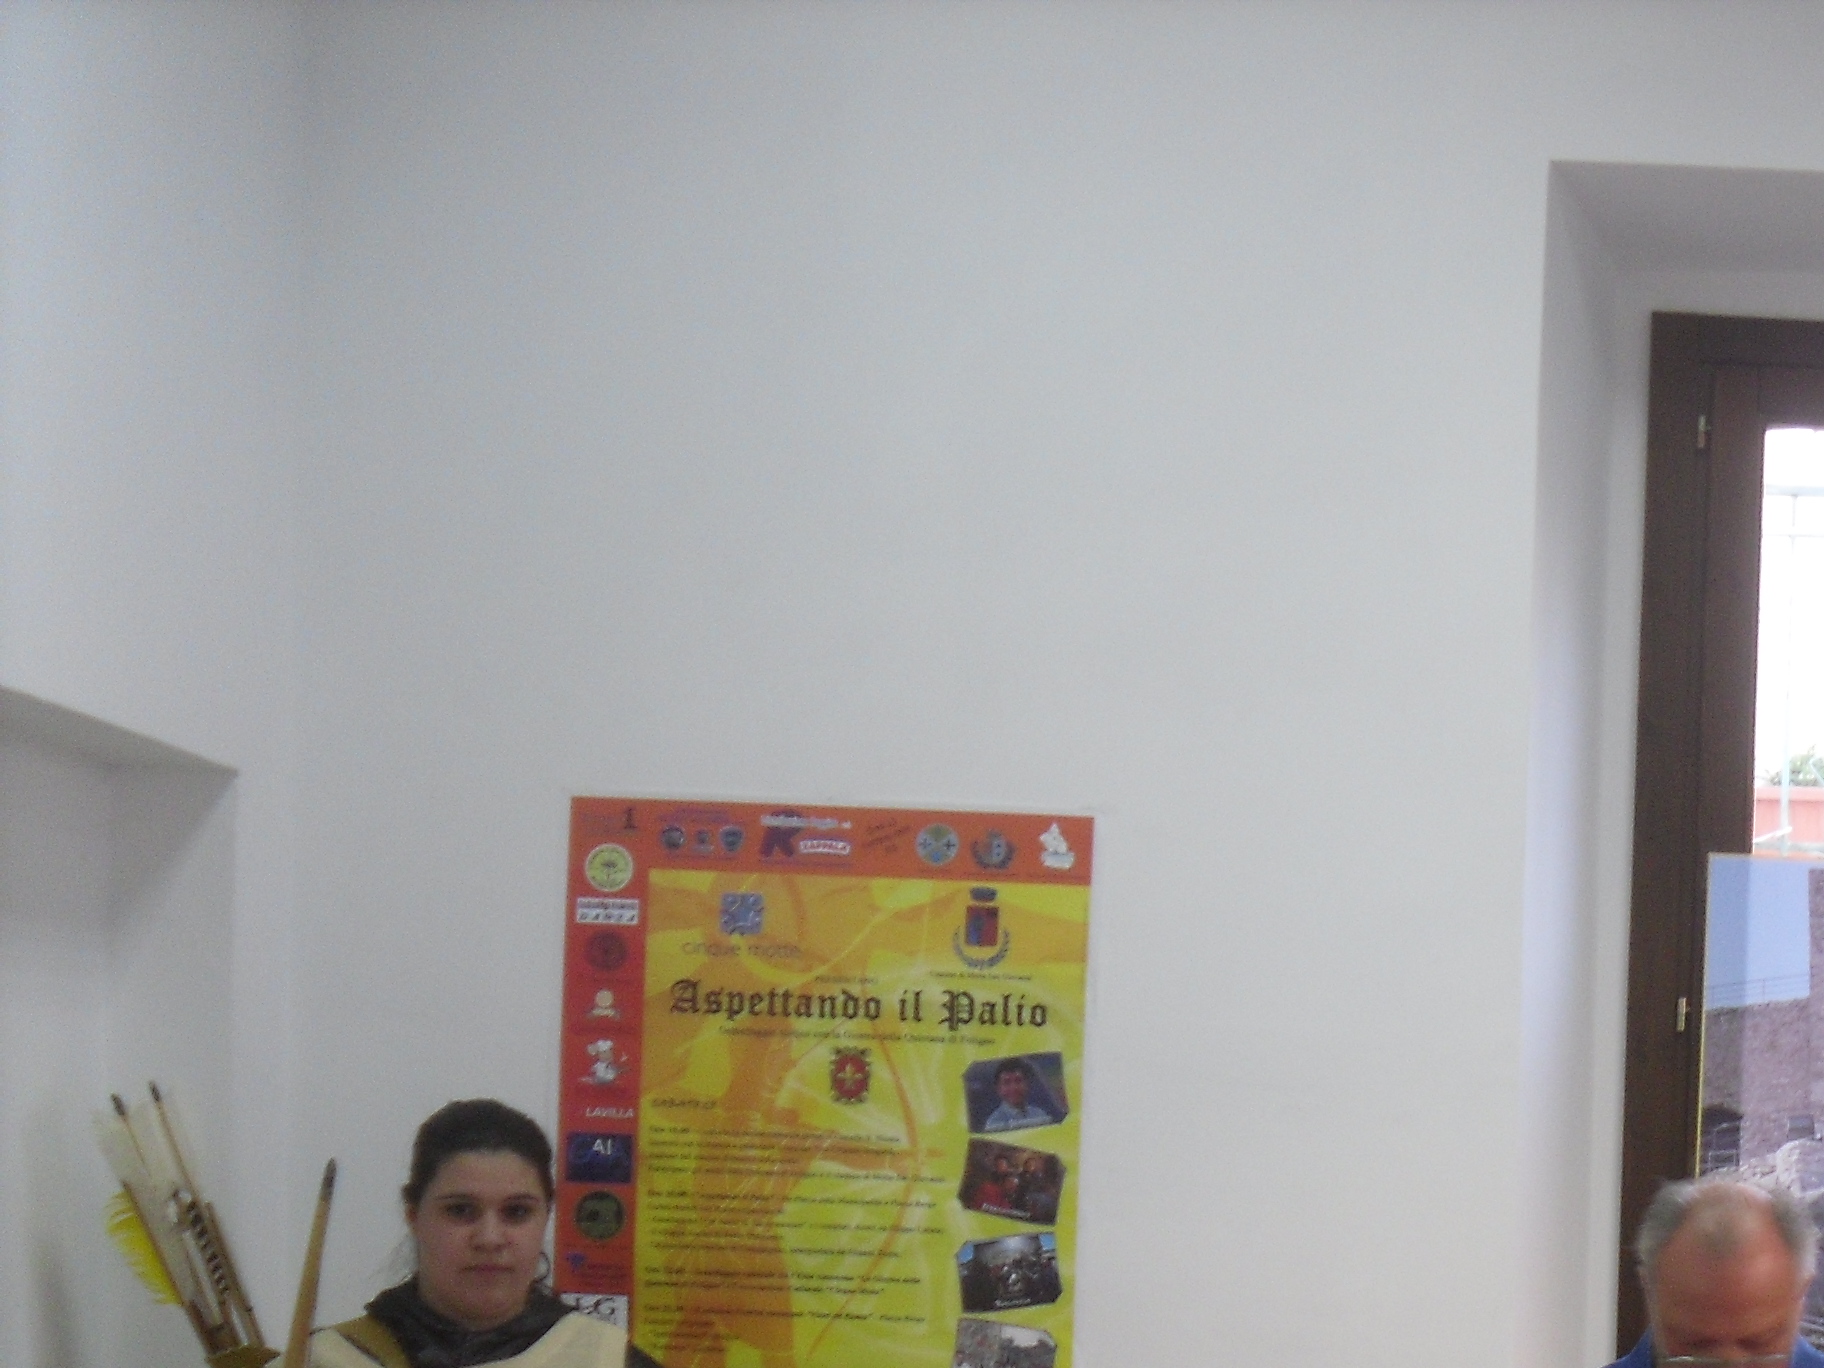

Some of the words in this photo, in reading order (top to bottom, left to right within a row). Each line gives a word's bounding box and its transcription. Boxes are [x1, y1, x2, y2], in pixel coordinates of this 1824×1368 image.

[671, 978, 882, 1022] Aspettando
[900, 988, 924, 1022] il
[936, 990, 1049, 1031] Palio
[586, 1107, 635, 1119] LAVILLA
